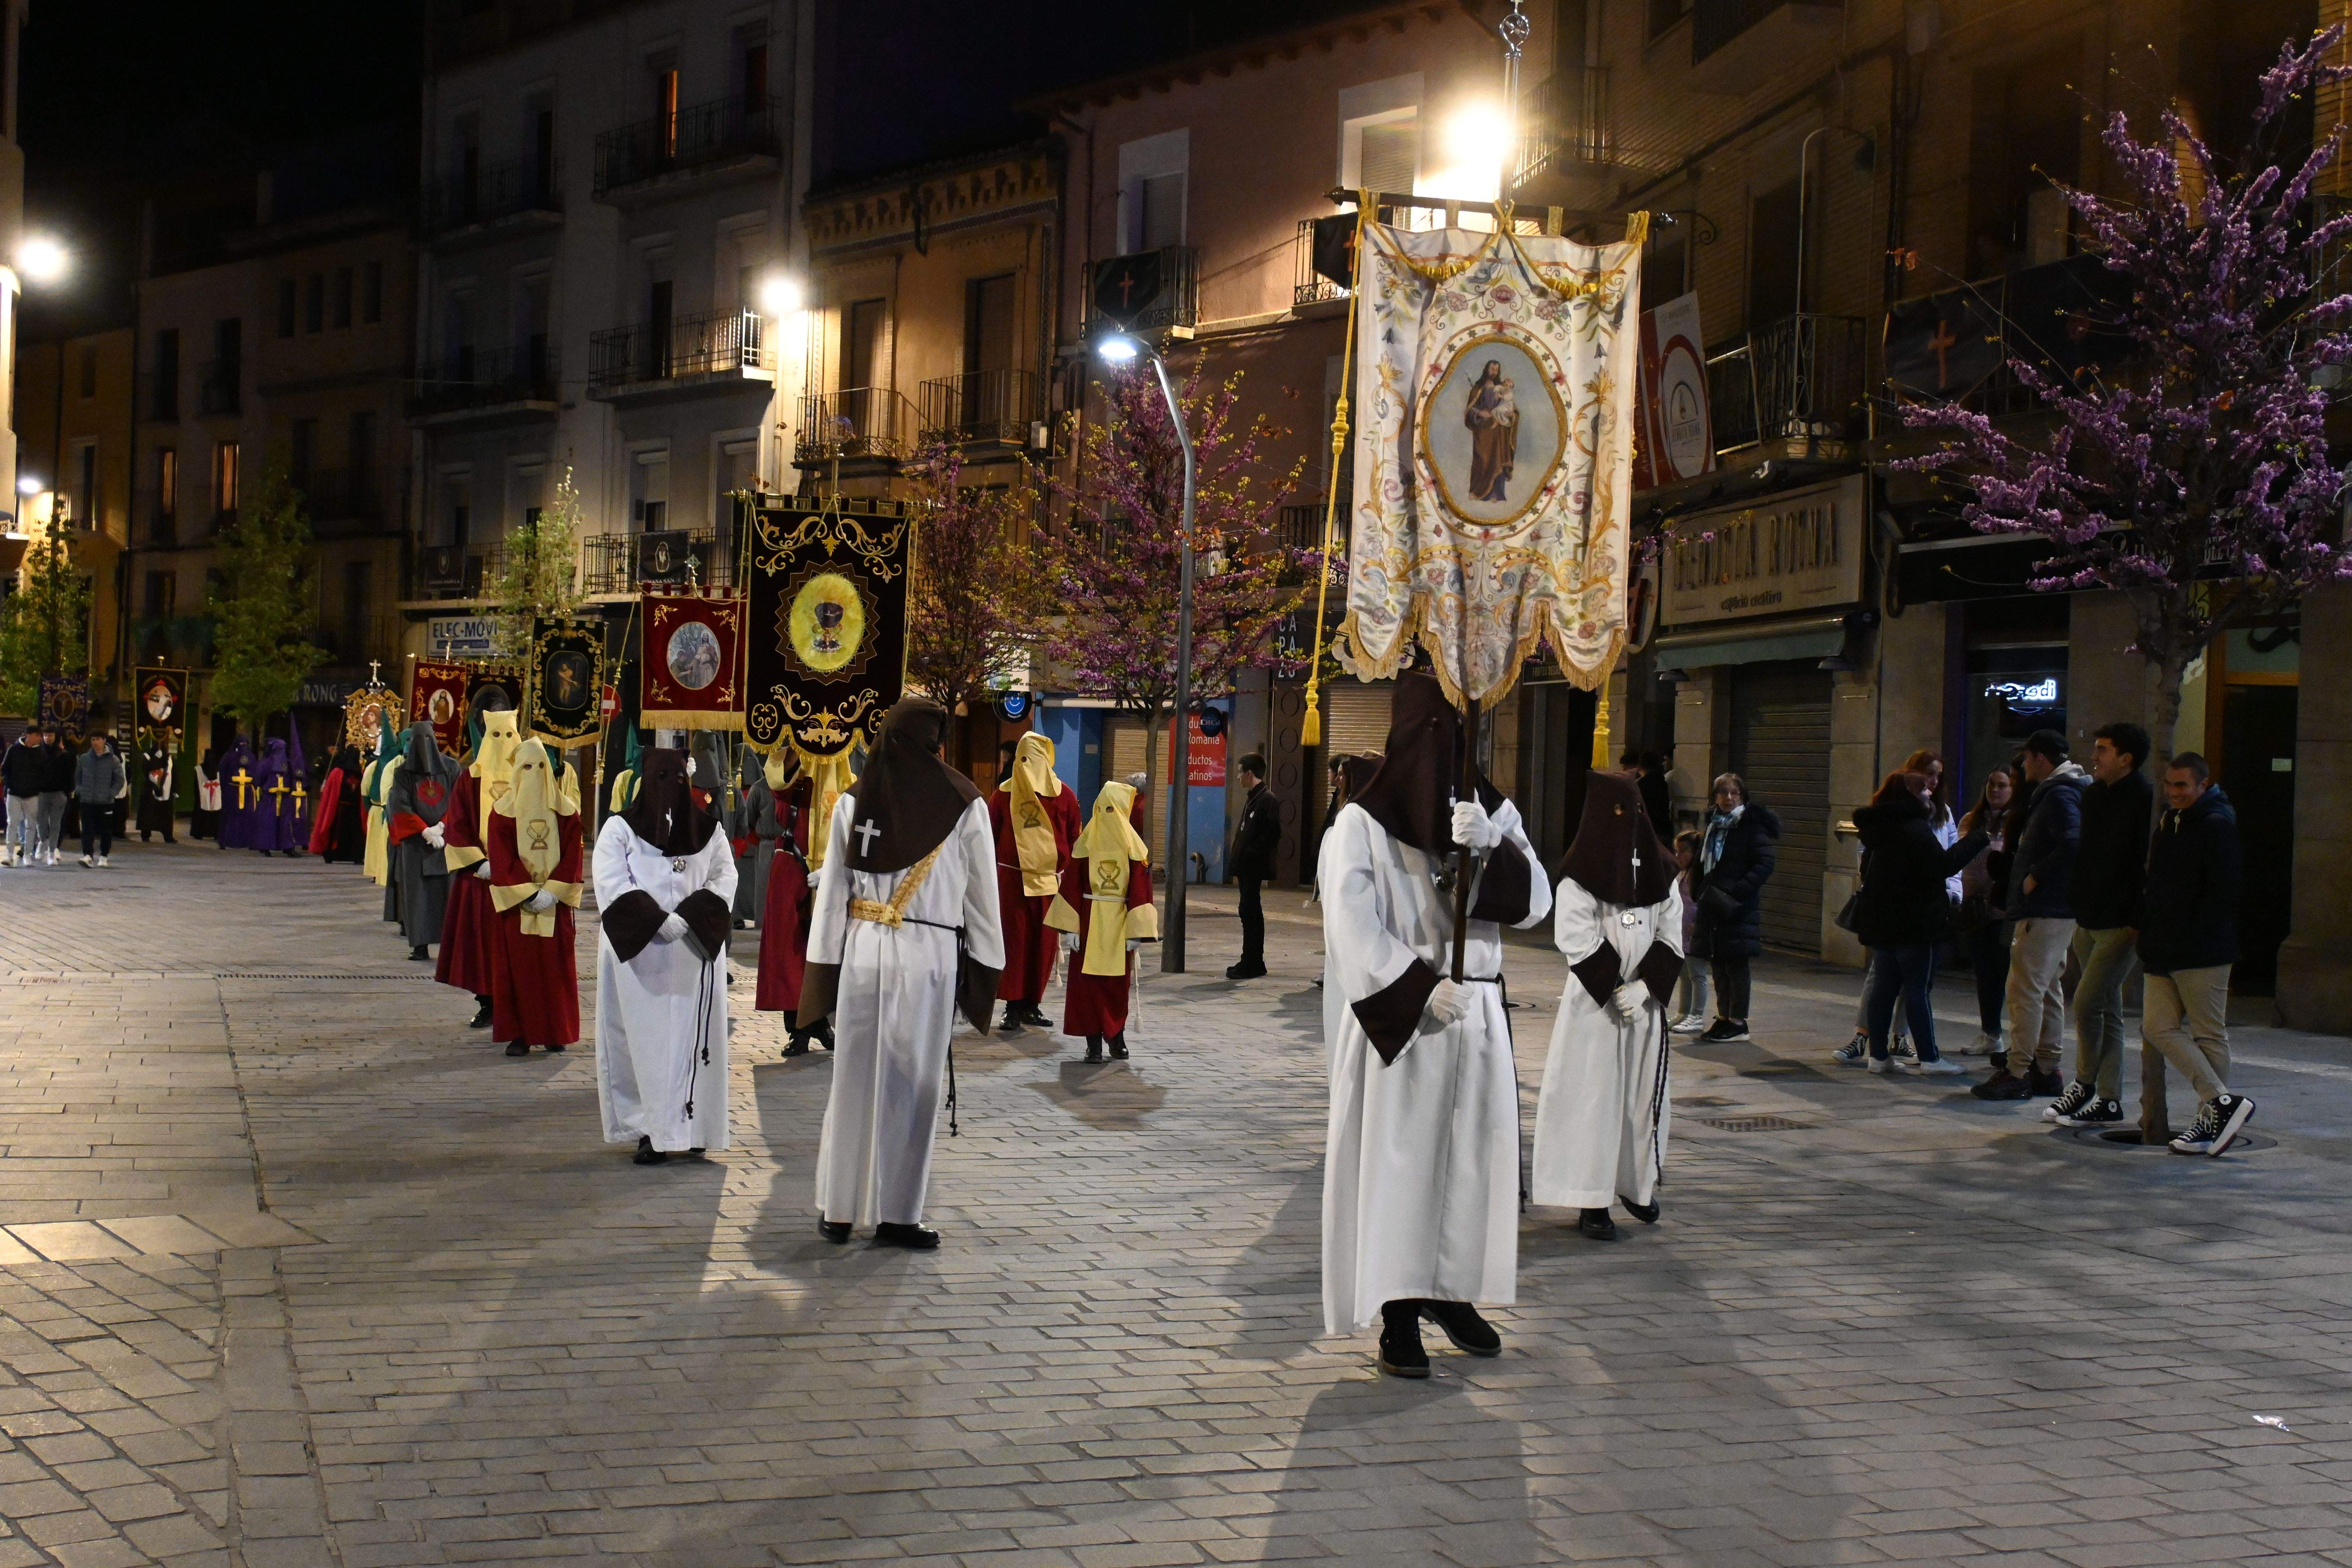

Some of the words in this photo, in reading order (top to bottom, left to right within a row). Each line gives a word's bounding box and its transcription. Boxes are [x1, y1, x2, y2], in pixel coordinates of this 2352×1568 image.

[1769, 503, 1837, 575] ROMA
[1721, 594, 1748, 612] espacio
[1750, 590, 1782, 607] creativo
[1188, 769, 1212, 781] atinos
